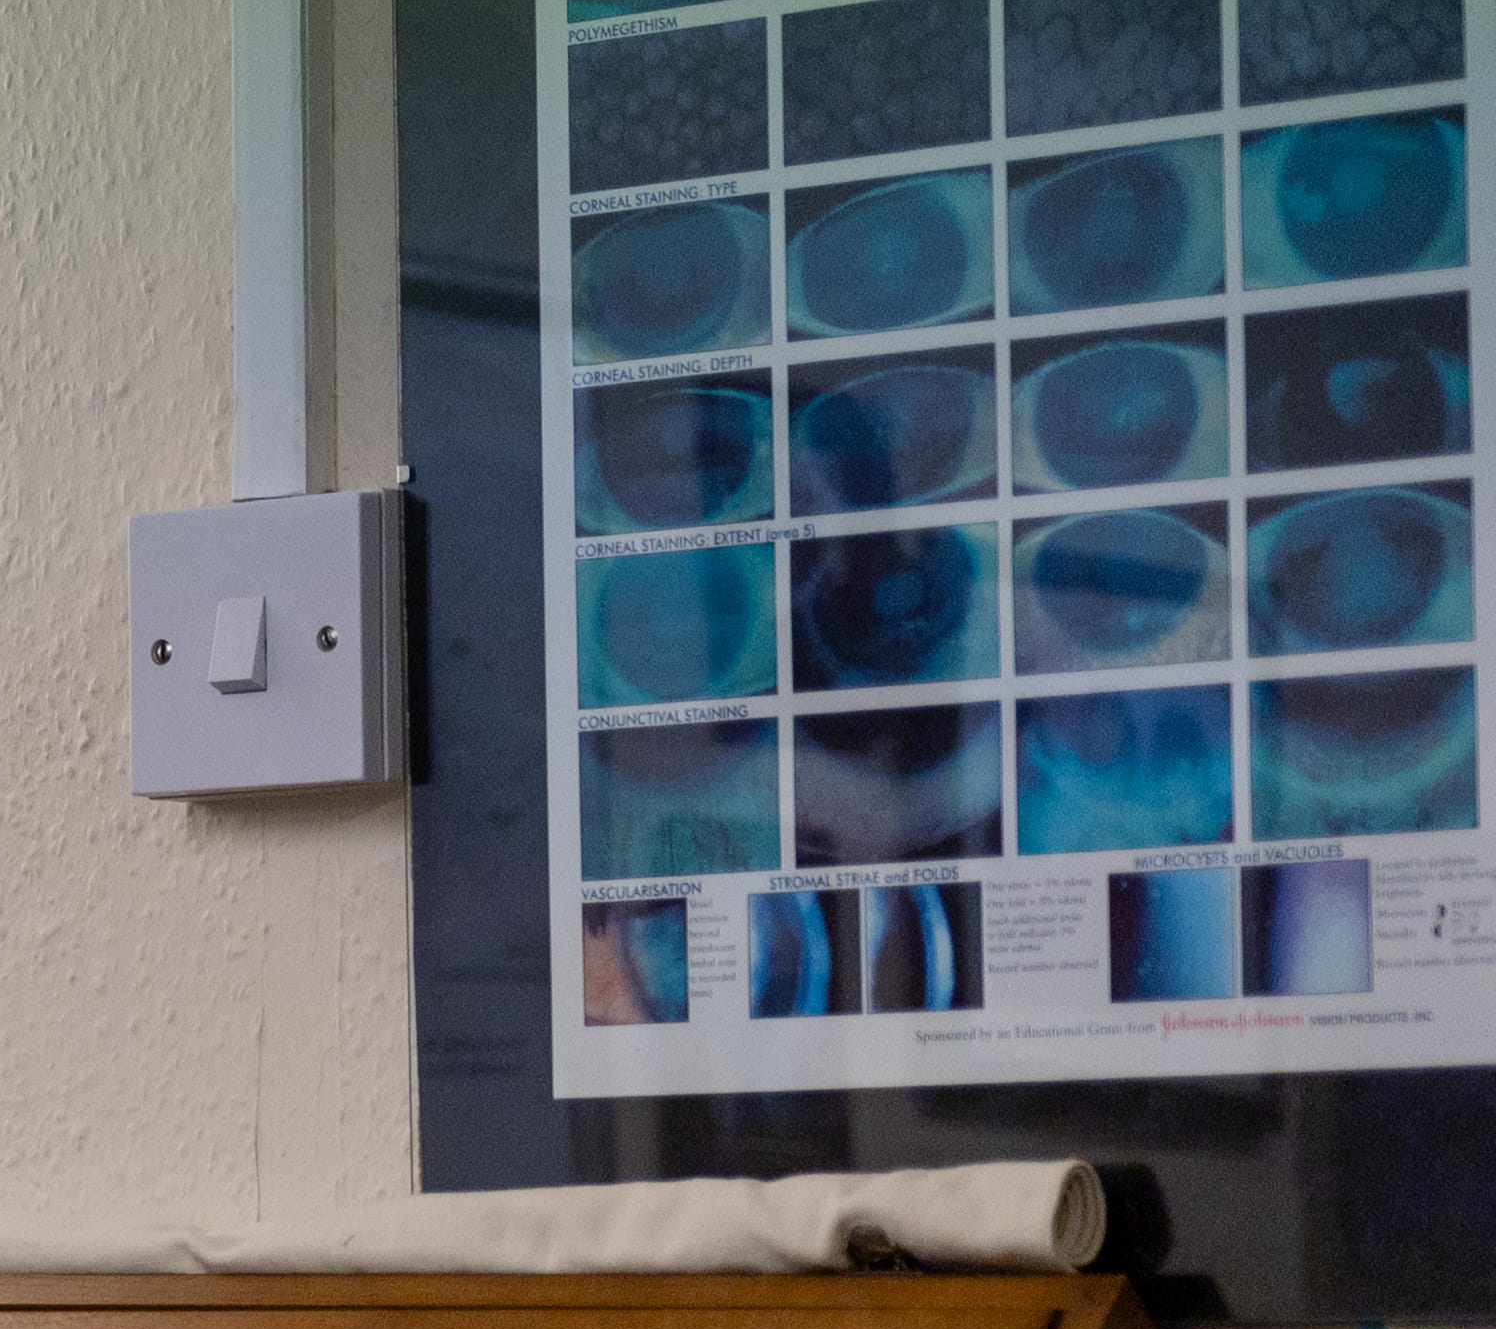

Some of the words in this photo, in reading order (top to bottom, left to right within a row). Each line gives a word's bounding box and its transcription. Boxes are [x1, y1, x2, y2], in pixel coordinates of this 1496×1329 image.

[568, 16, 677, 44] POLYMEGETHISM
[570, 196, 631, 215] CORNEAL
[634, 186, 703, 208] STAINING:
[707, 180, 738, 199] TYPE
[572, 369, 634, 388] CORNEAL
[637, 360, 707, 382] STAINING:
[710, 353, 753, 372] DEPTH
[575, 540, 637, 559] CORNEAL
[640, 530, 709, 554] STAINING:
[713, 527, 761, 547] EXTENT
[579, 710, 681, 730] CONJUNCTIVAL
[684, 704, 749, 722] STAINING
[1236, 849, 1260, 867] and
[1265, 844, 1344, 864] VACUOLES
[581, 881, 702, 902] VASCULARISATION
[769, 872, 830, 891] STROMAL
[834, 869, 881, 888] STRIAE
[887, 869, 911, 886] and
[915, 866, 960, 884] FOLDS
